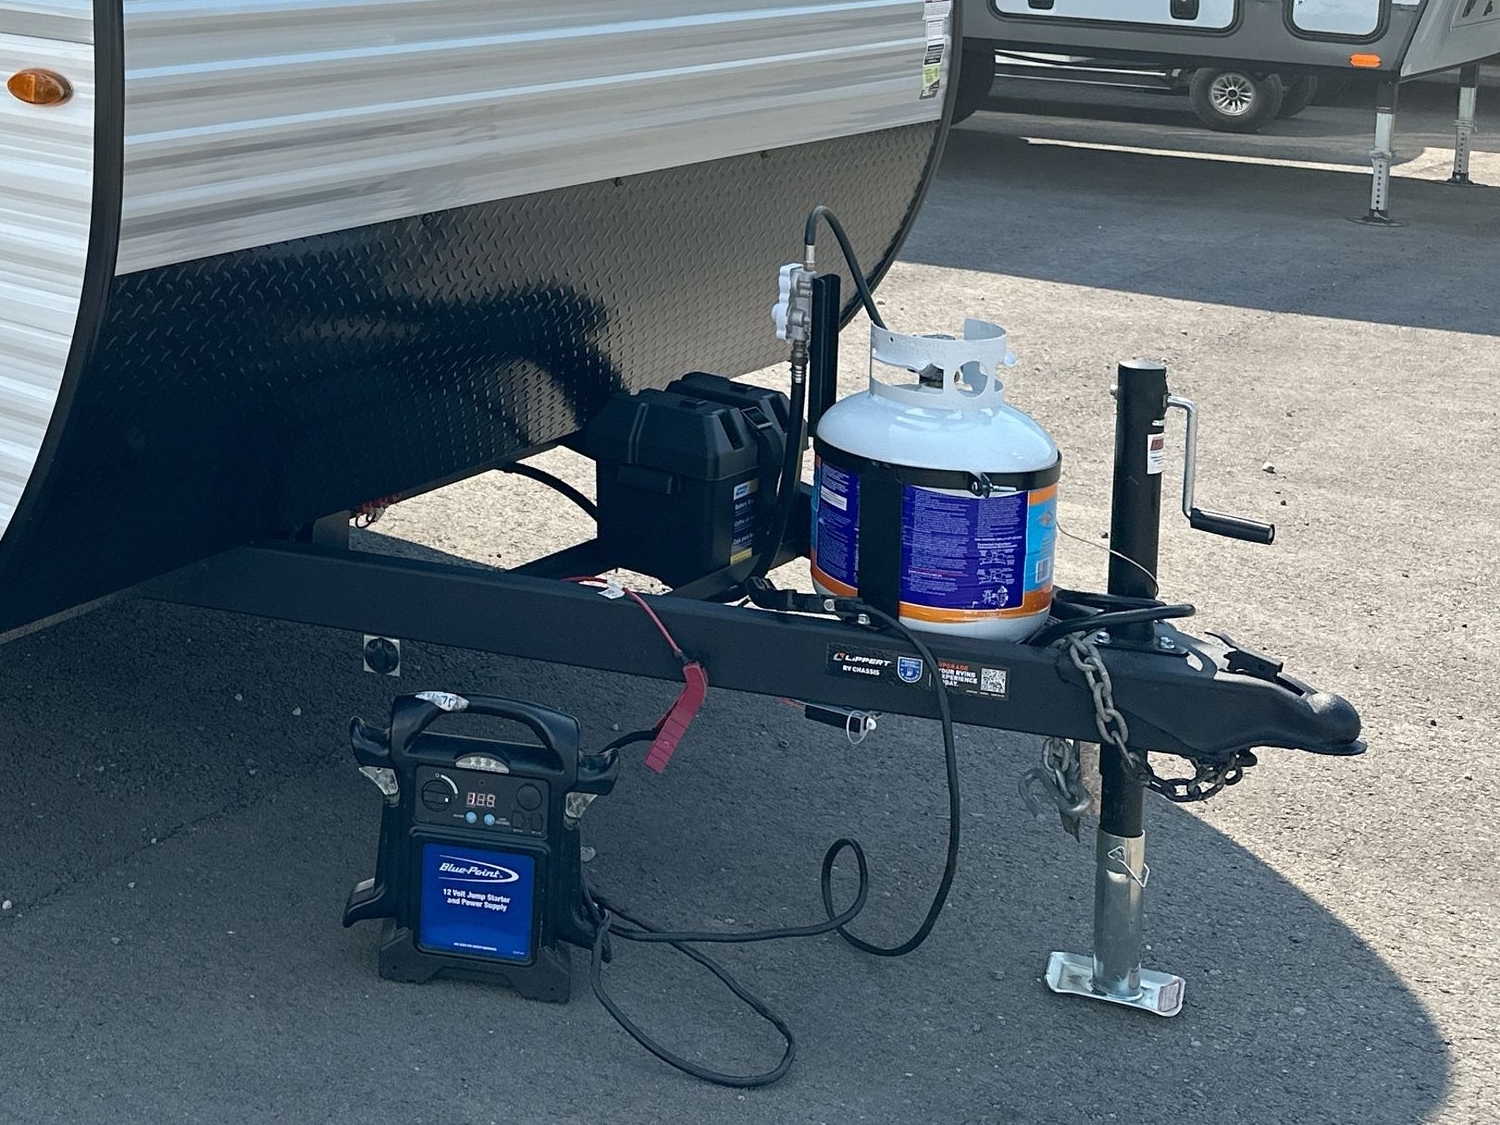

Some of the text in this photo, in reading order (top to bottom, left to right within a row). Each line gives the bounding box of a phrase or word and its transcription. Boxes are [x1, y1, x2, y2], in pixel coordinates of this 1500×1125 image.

[845, 654, 892, 667] LIPPERT
[842, 664, 881, 676] RV CHASSIS
[941, 674, 978, 684] XPERIENCE
[439, 862, 501, 878] Blue-Point
[442, 888, 511, 904] 12 Volt Jump Starter
[447, 897, 508, 912] and Power Supply
